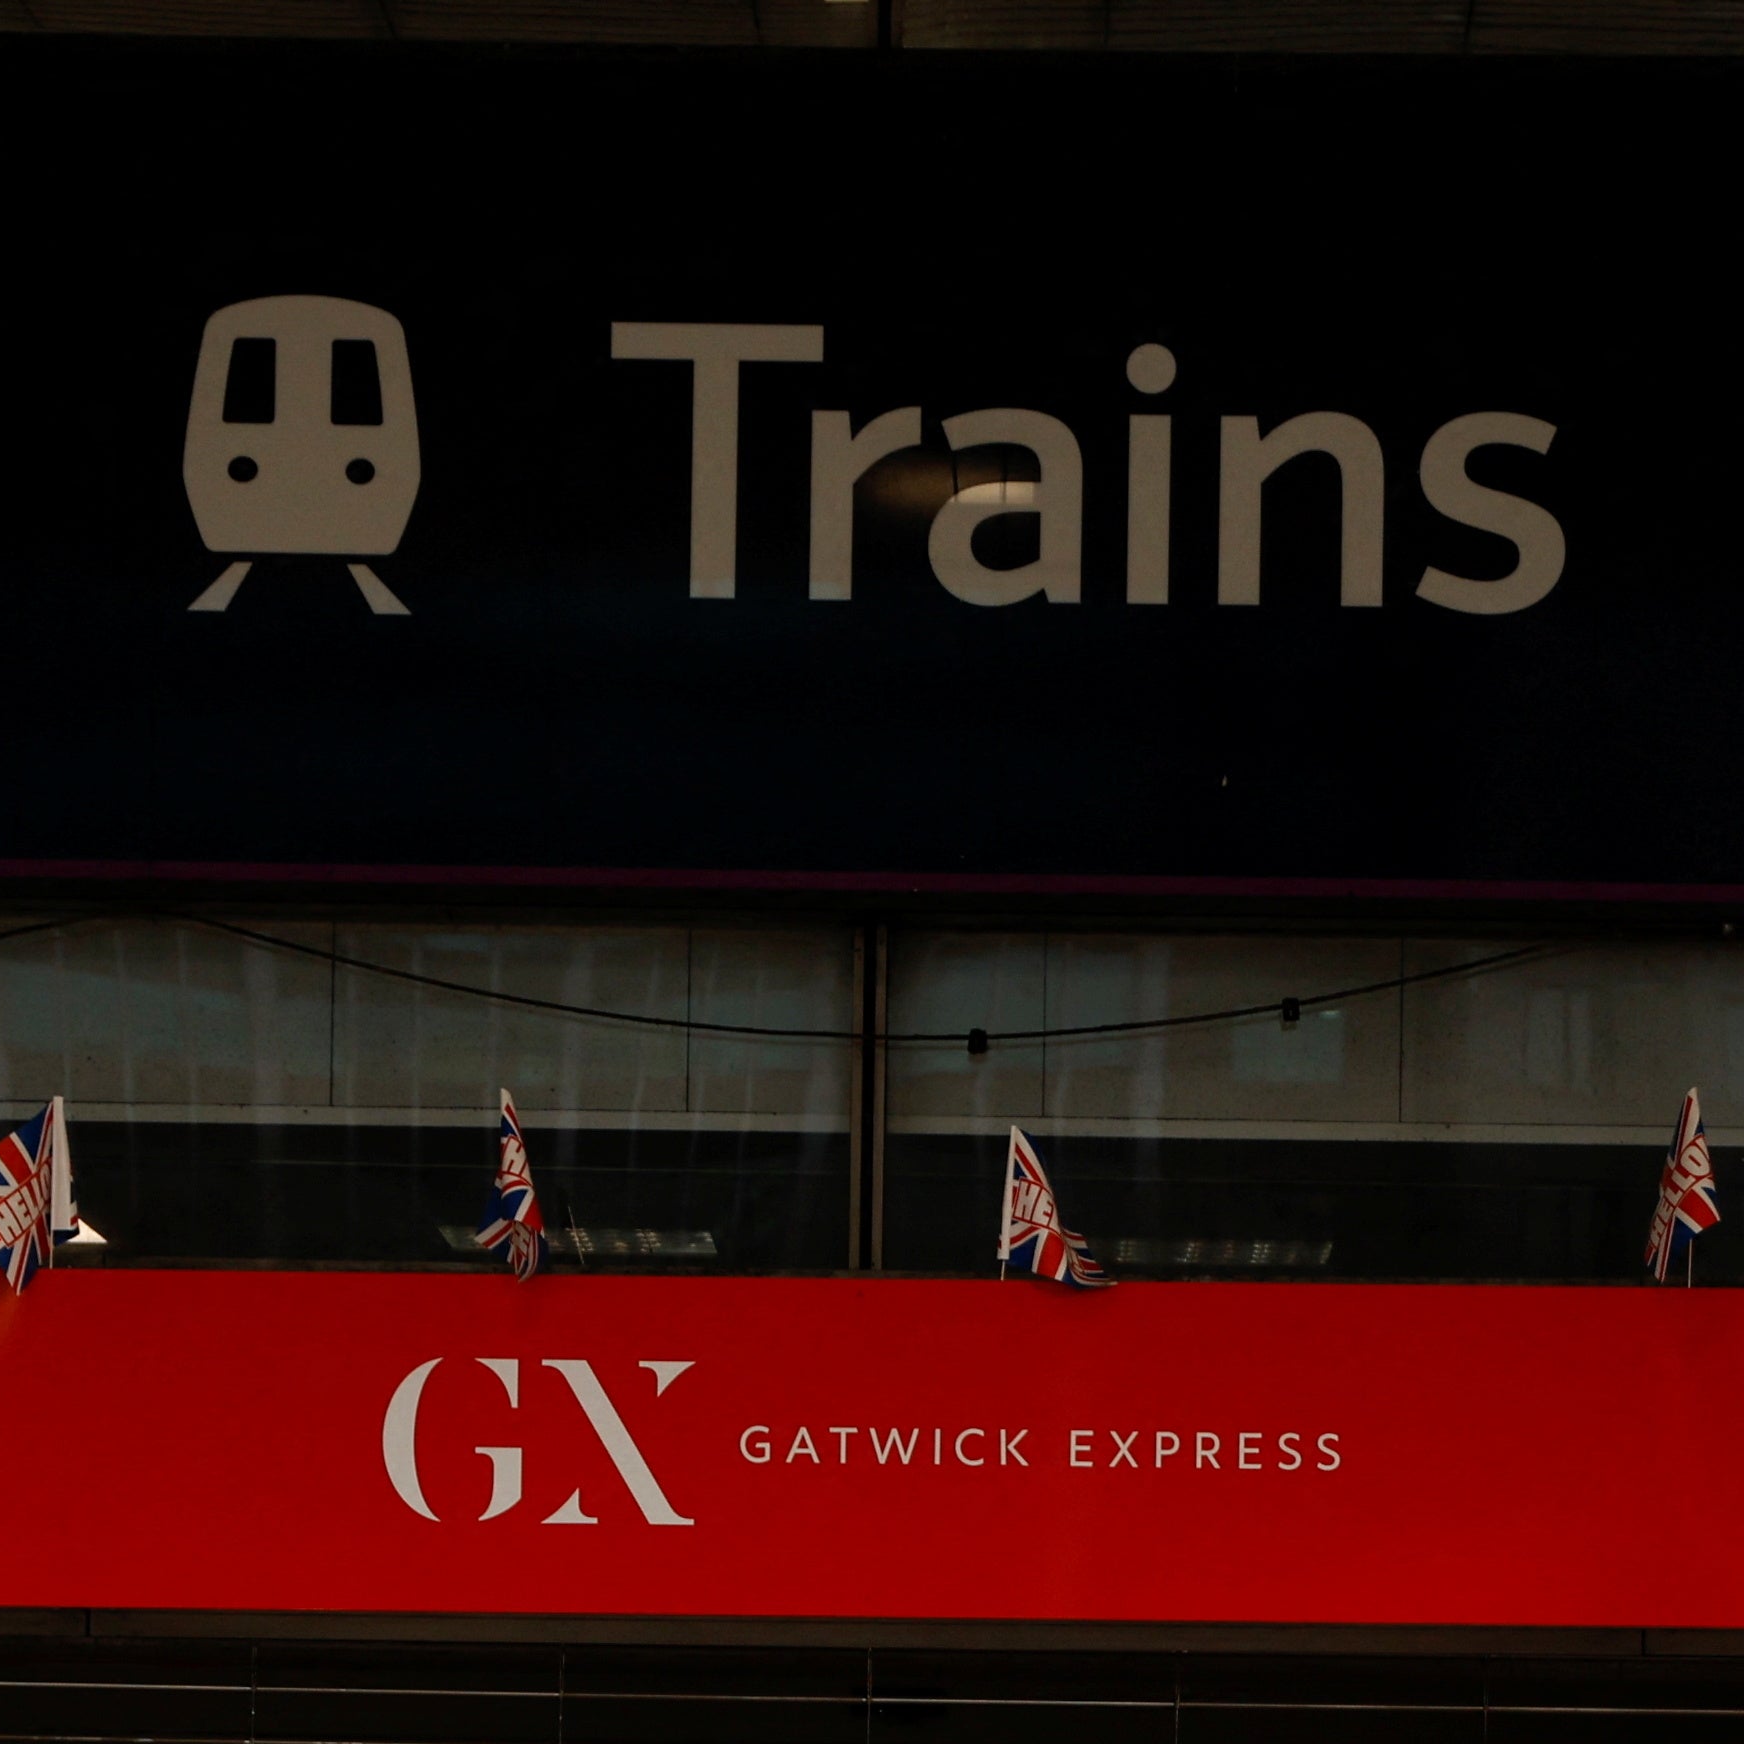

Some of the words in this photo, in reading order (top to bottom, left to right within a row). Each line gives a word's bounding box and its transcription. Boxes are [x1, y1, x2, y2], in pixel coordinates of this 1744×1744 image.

[610, 321, 1567, 615] Trains
[382, 1357, 697, 1526] GX
[739, 1424, 1031, 1468] GATWICK
[1068, 1428, 1343, 1472] EXPRESS
